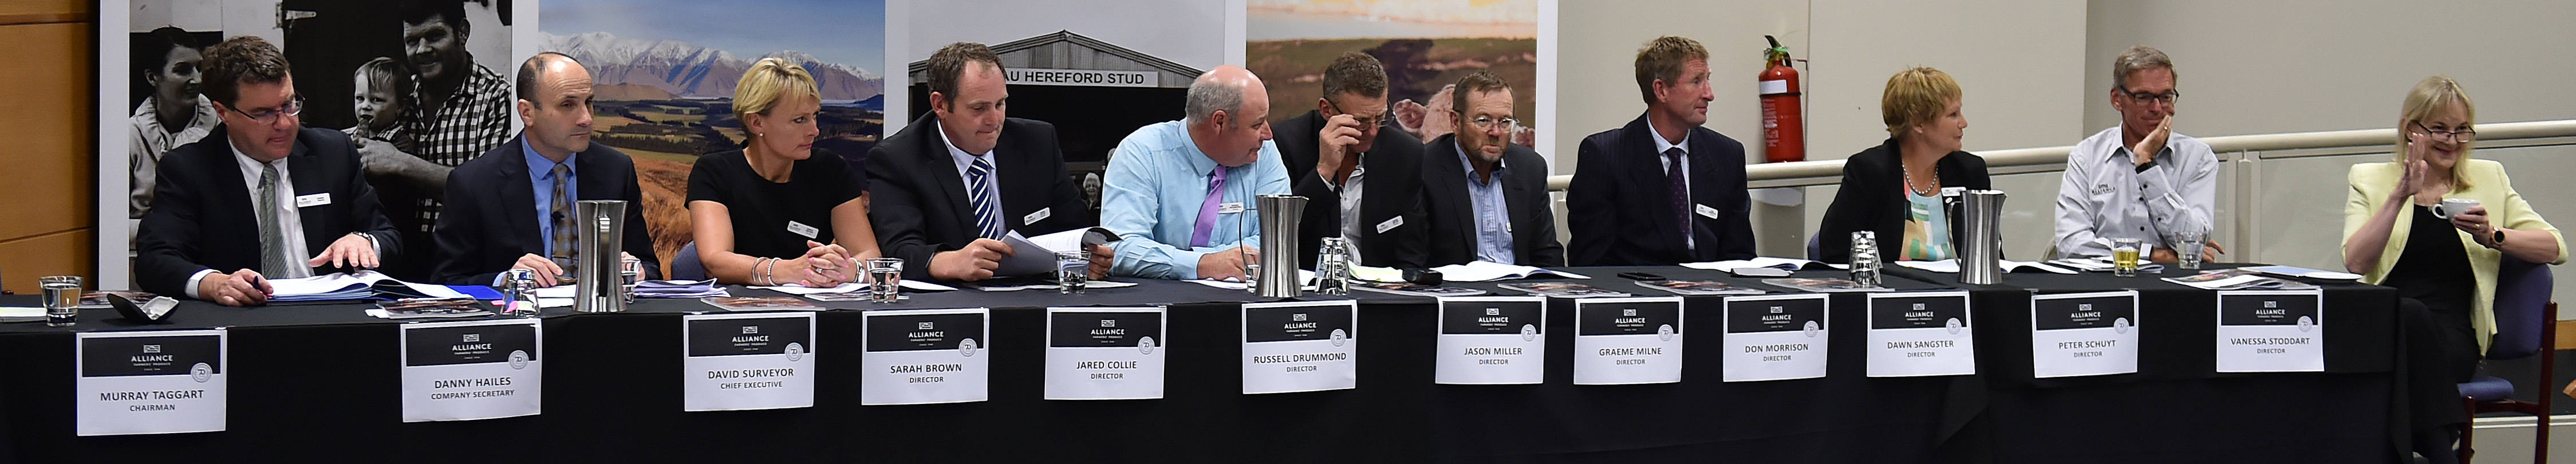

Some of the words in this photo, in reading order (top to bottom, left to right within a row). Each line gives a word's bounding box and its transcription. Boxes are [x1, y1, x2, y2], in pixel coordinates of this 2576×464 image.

[1025, 72, 1103, 83] HEREFORD
[1108, 73, 1144, 84] STUD
[1766, 344, 1809, 352] MORRISON
[1914, 340, 1954, 348] SANGSTER
[2085, 340, 2116, 348] SCHUYT
[1254, 355, 1290, 363] RUSSELL
[1293, 353, 1346, 362] DRUMMOND
[890, 365, 922, 373] SARAH
[926, 364, 962, 372] BROWN
[1107, 361, 1137, 369] COLLIE
[708, 371, 739, 379] DAVID
[743, 368, 794, 378] SURVEYOR
[435, 379, 472, 388] DANNY
[476, 377, 511, 387] HAILES
[100, 391, 149, 401] MURRAY
[152, 390, 204, 400] TAGGART
[431, 392, 471, 400] COMPANY
[473, 390, 515, 398] SECRETARY
